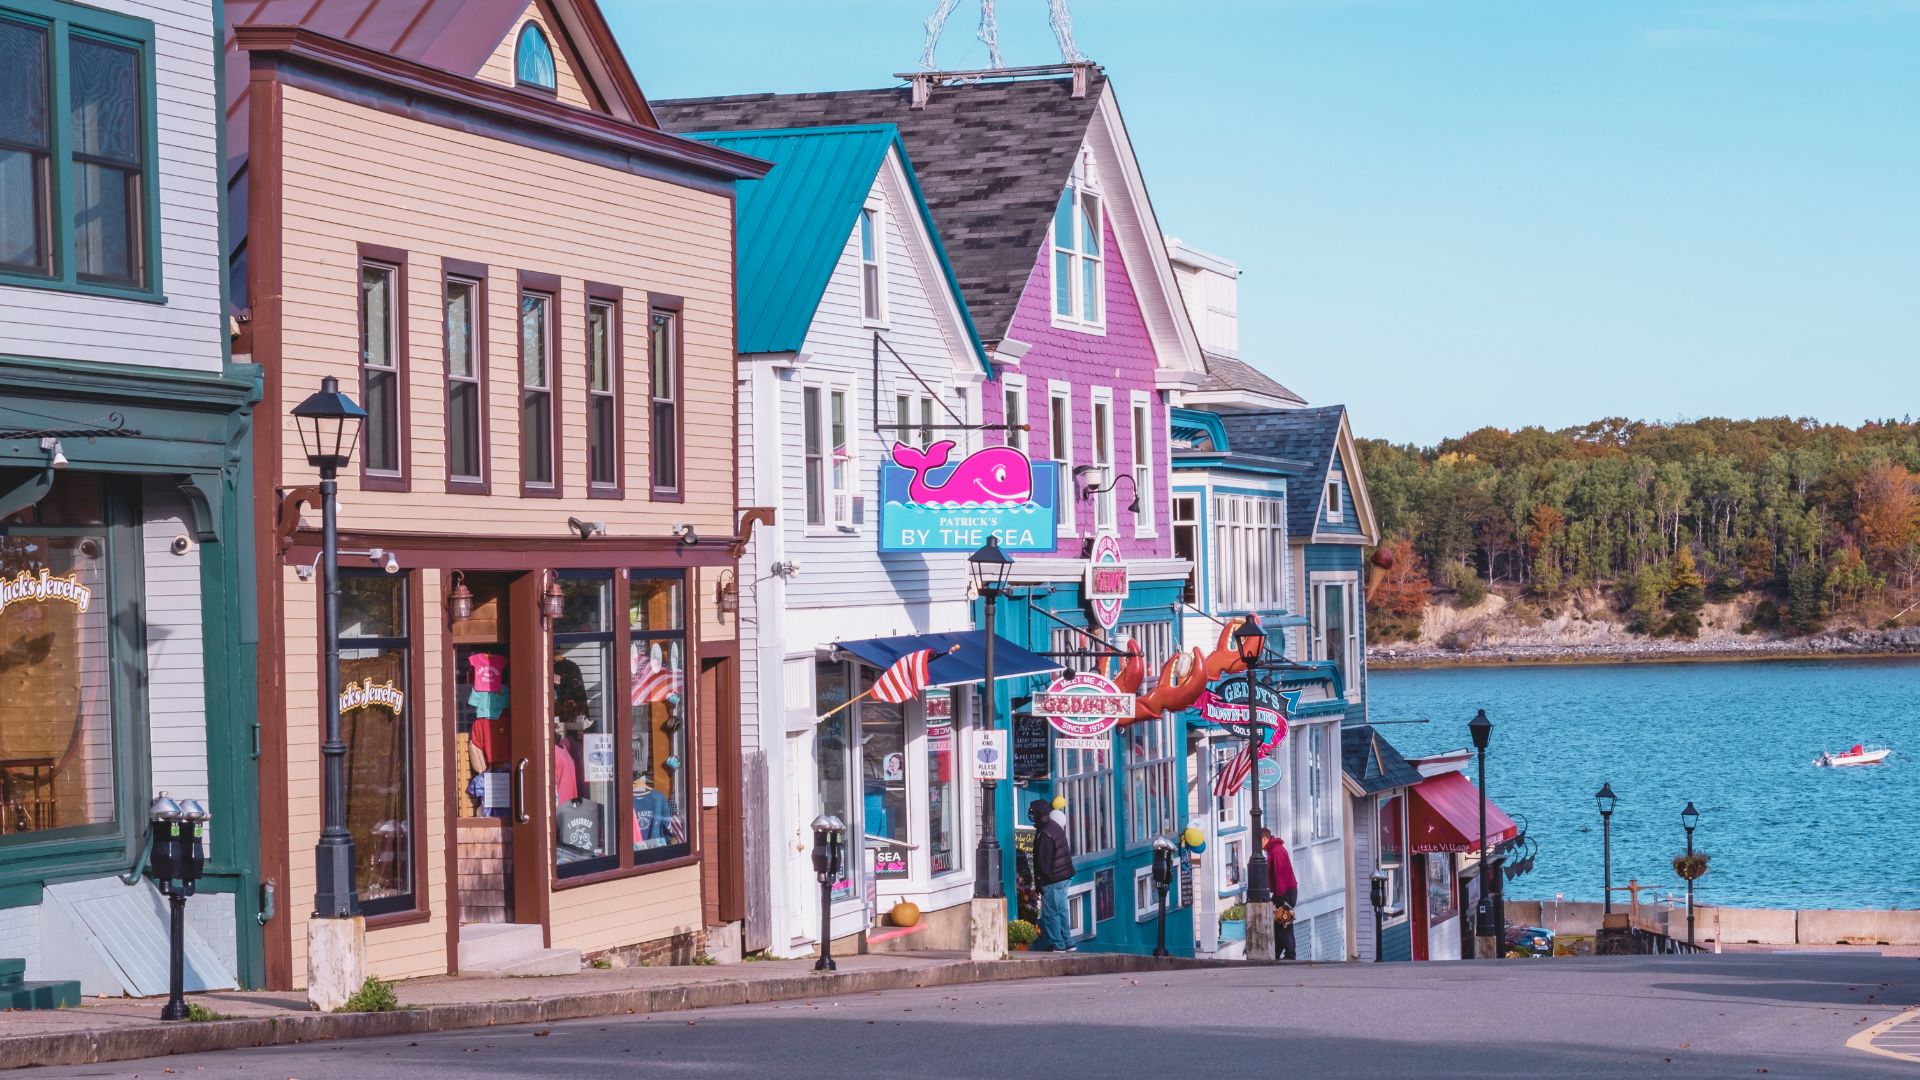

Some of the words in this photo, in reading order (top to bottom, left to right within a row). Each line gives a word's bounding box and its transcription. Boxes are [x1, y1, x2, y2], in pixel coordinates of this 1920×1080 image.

[940, 517, 998, 526] PATRICK'S
[901, 529, 930, 545] BY
[940, 529, 983, 545] THE
[991, 529, 1035, 545] SEA
[36, 568, 91, 613] Jewelry
[1083, 676, 1096, 685] ME
[1097, 680, 1108, 689] AT
[340, 681, 361, 714] ck's
[361, 677, 403, 715] Jewelry
[1207, 703, 1279, 727] DOWN-UDER
[1061, 722, 1085, 732] SINCE
[1089, 722, 1105, 731] 1974
[1056, 740, 1108, 748] RESTAURANT
[1410, 843, 1438, 853] Little
[1439, 842, 1470, 853] Village
[877, 852, 901, 862] SEA
